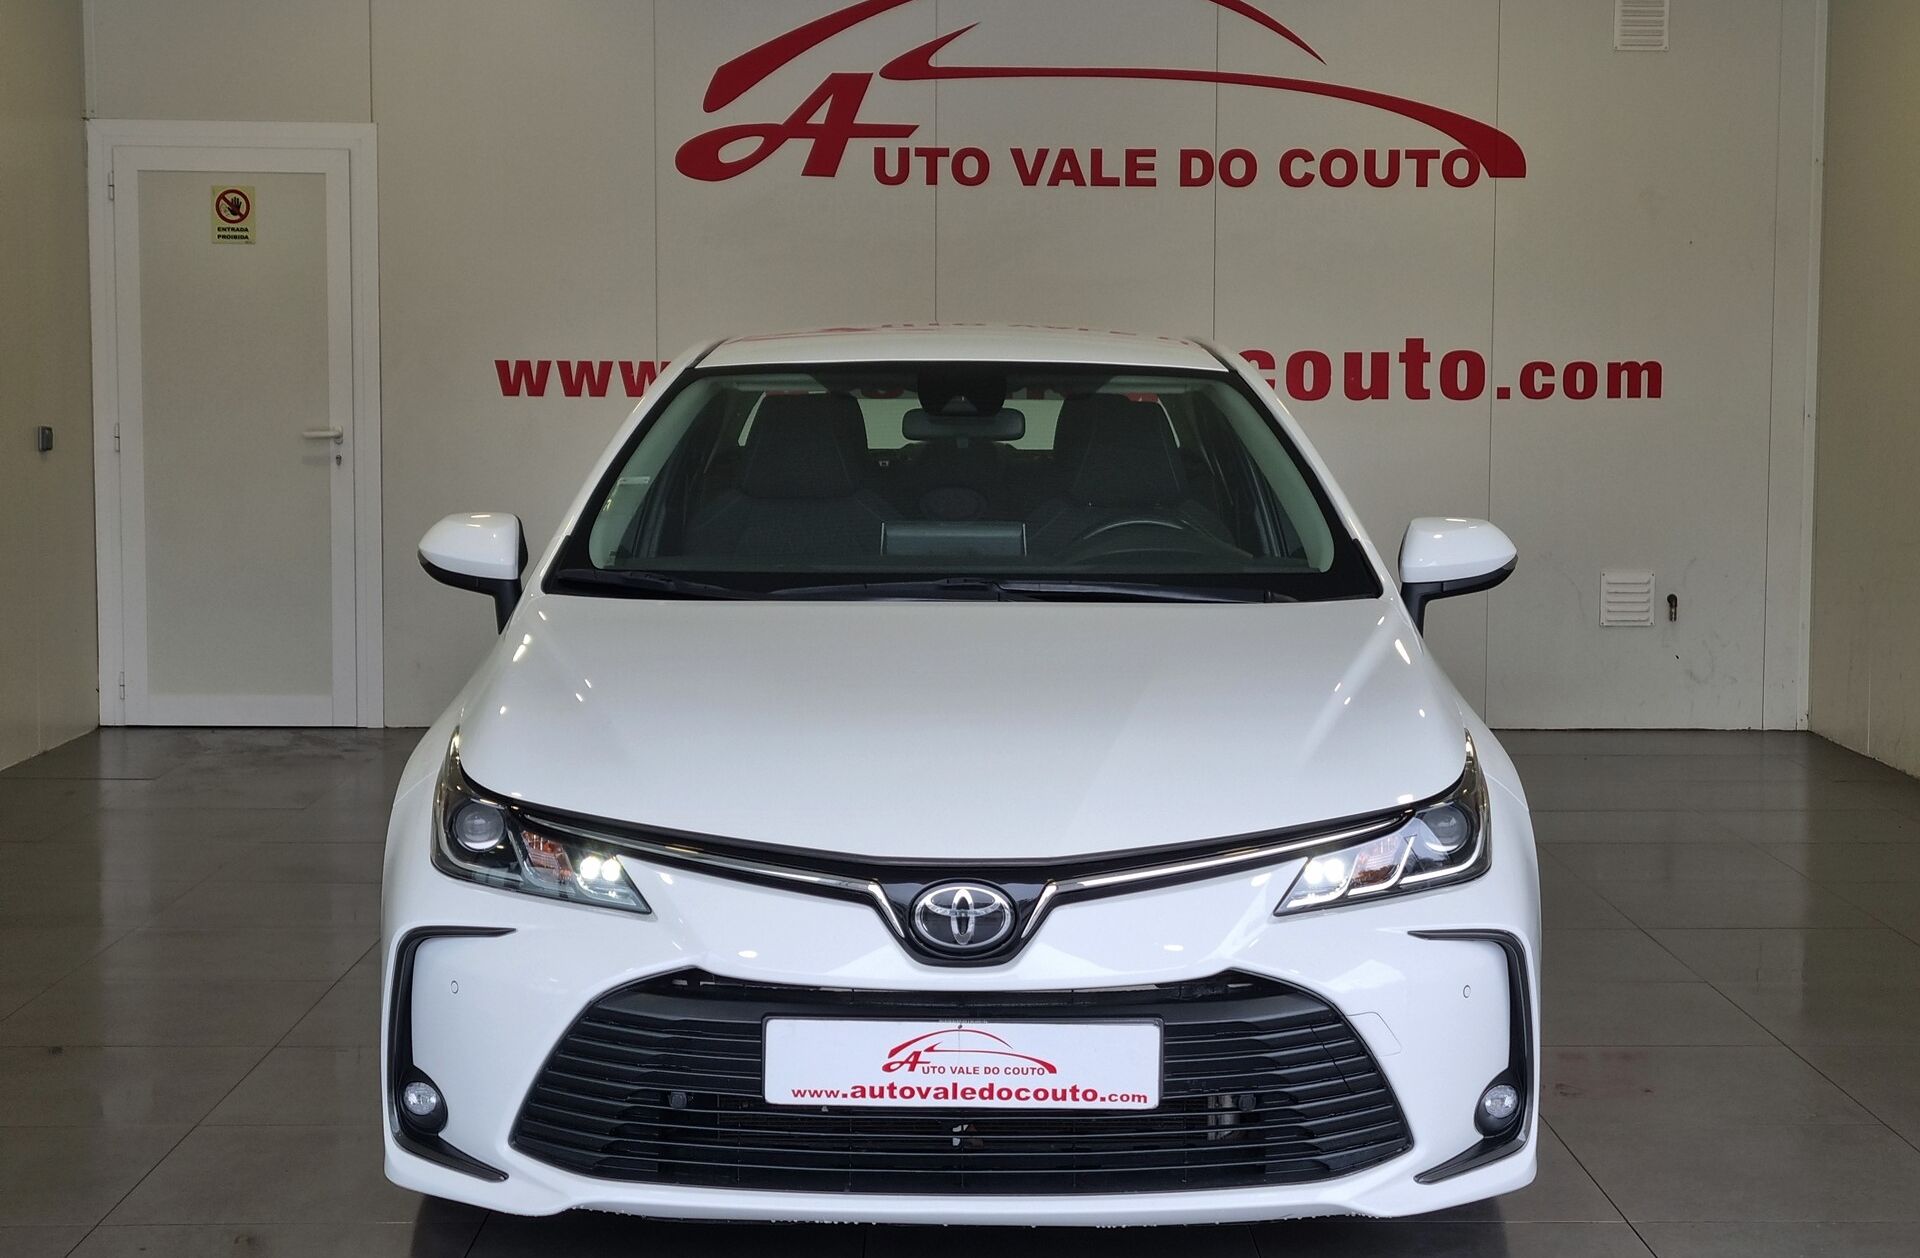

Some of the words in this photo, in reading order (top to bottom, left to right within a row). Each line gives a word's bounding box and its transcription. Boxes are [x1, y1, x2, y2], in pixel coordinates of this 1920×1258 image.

[675, 72, 990, 188] AUTO
[1011, 147, 1158, 188] VALE
[1179, 148, 1258, 188] DO
[1279, 148, 1481, 189] COUTO
[881, 1050, 946, 1075] AUTO
[949, 1065, 980, 1075] VALE
[983, 1066, 1000, 1075] DO
[1003, 1066, 1046, 1077] COUTO
[790, 1081, 1149, 1105] www.autovaledocouto.com
